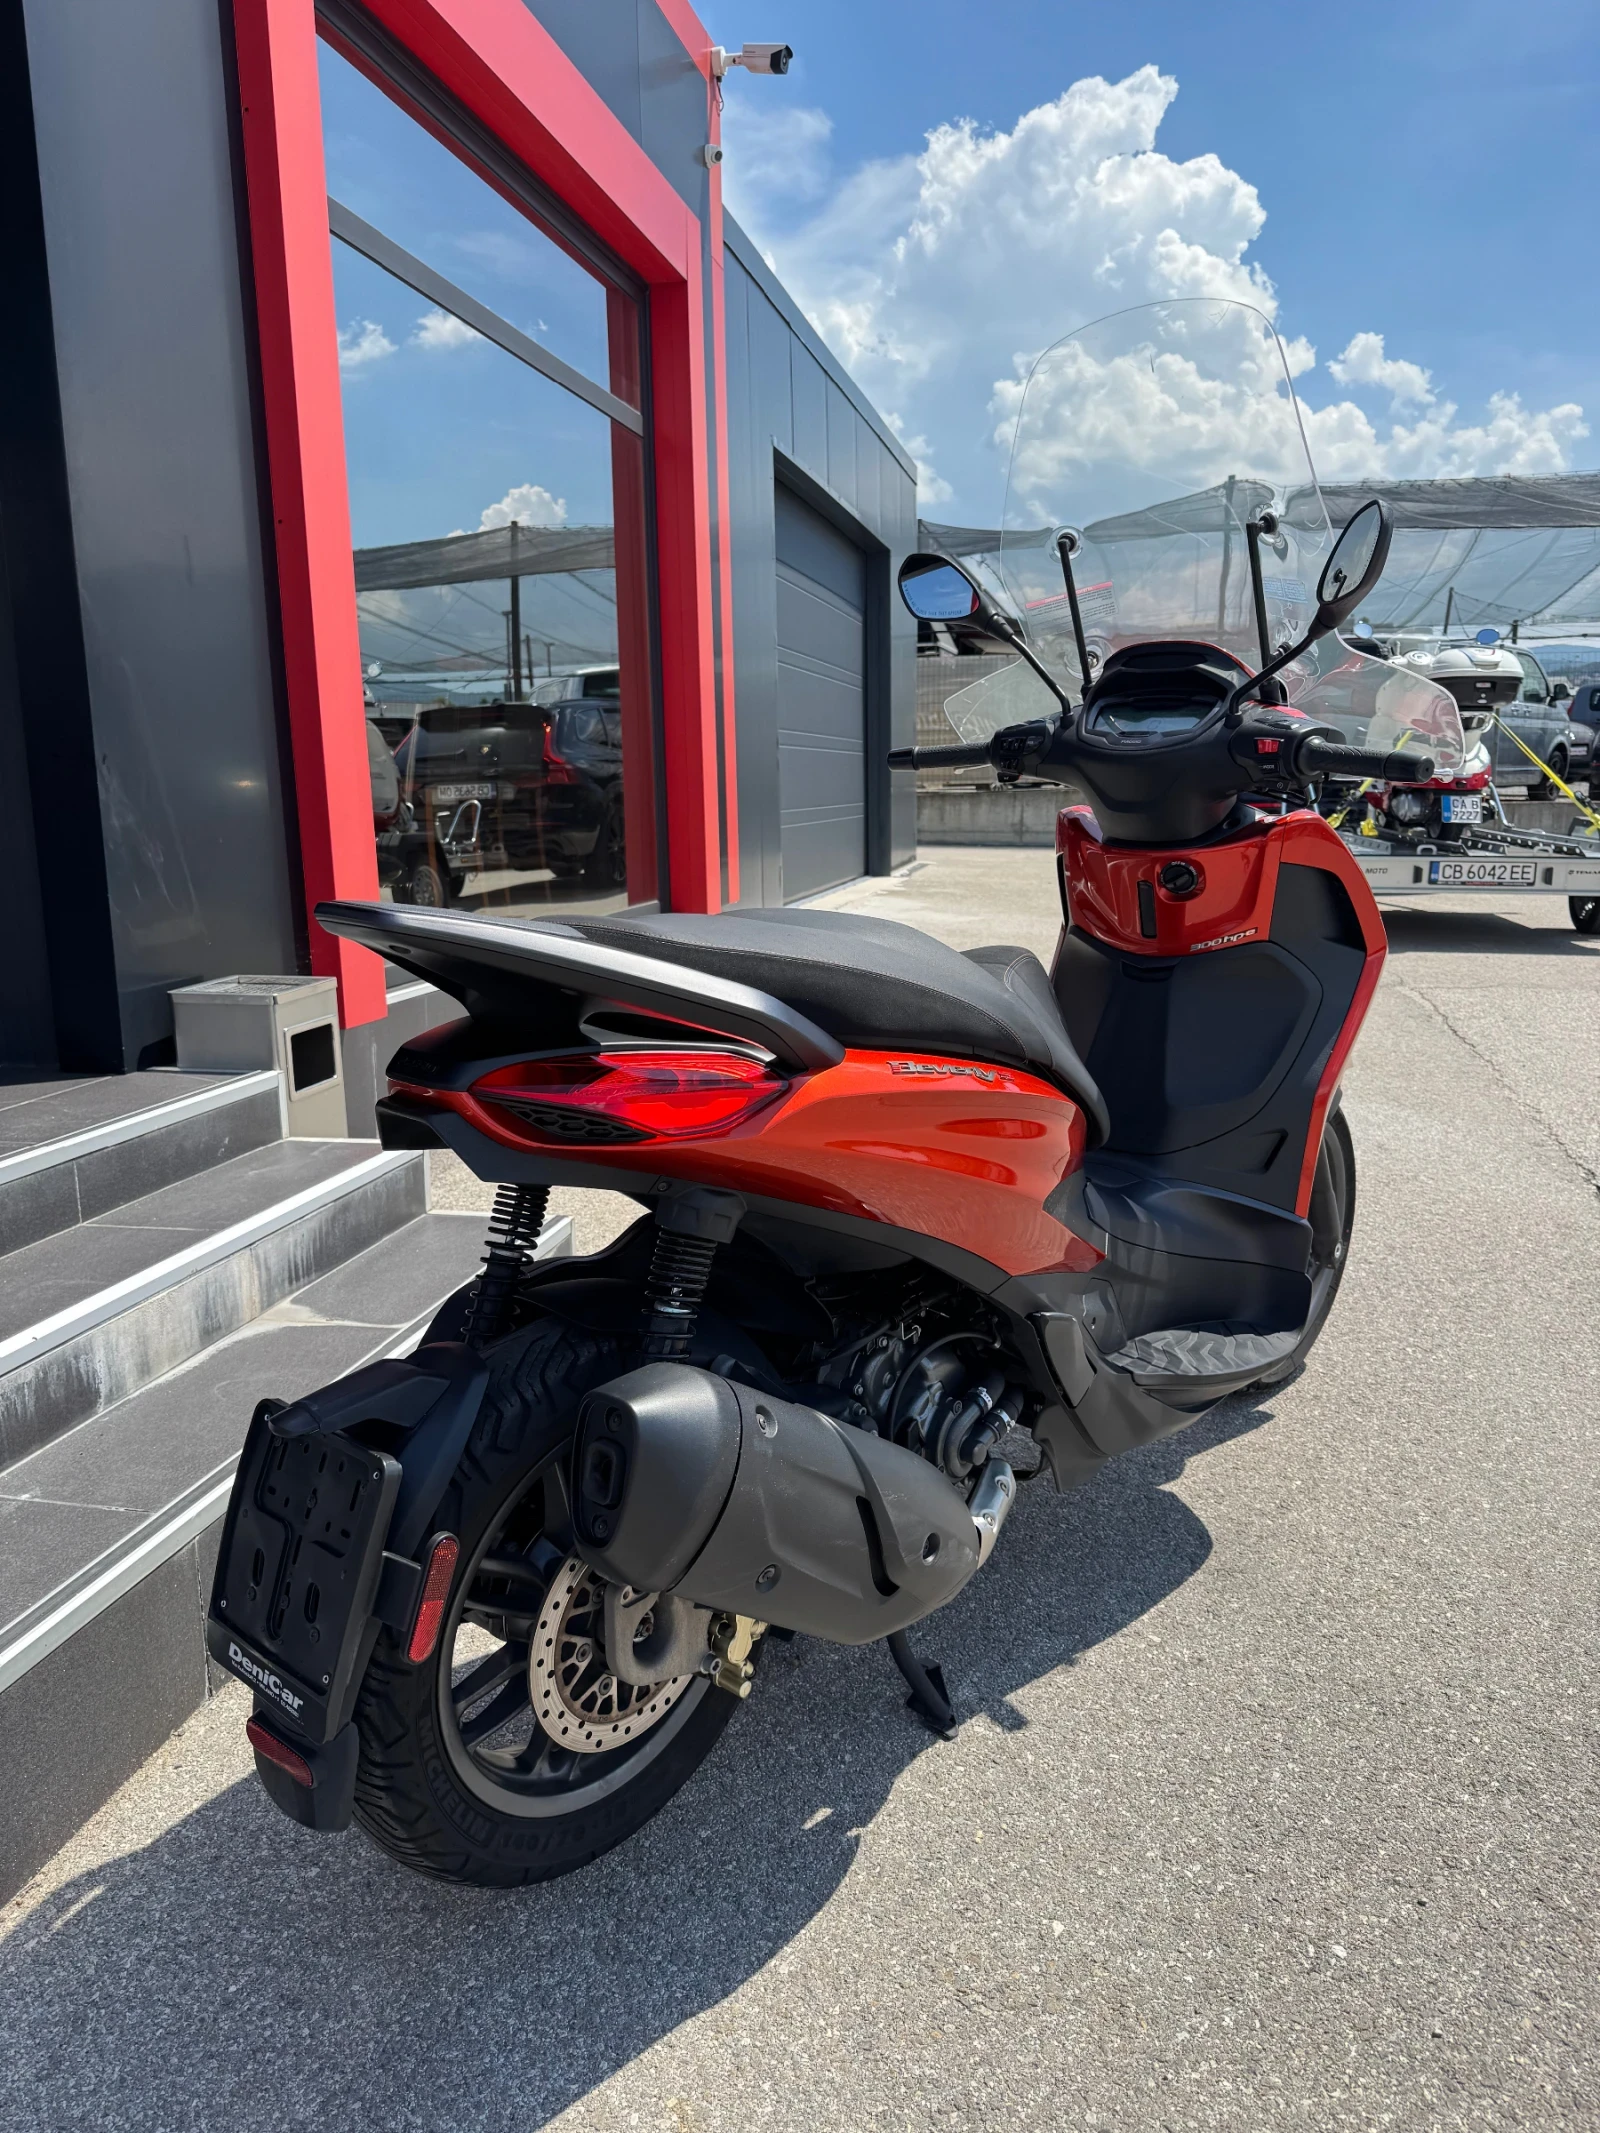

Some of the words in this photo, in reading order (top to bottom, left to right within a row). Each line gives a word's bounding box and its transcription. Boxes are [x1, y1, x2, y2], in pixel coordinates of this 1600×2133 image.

[1452, 799, 1467, 810] CA
[1471, 800, 1479, 810] B
[1452, 810, 1480, 821] 9227
[1365, 867, 1389, 875] MOTO
[1442, 864, 1463, 880] CB
[1466, 864, 1508, 881] 6042
[1509, 865, 1532, 881] EE
[228, 1641, 304, 1710] DeniCar
